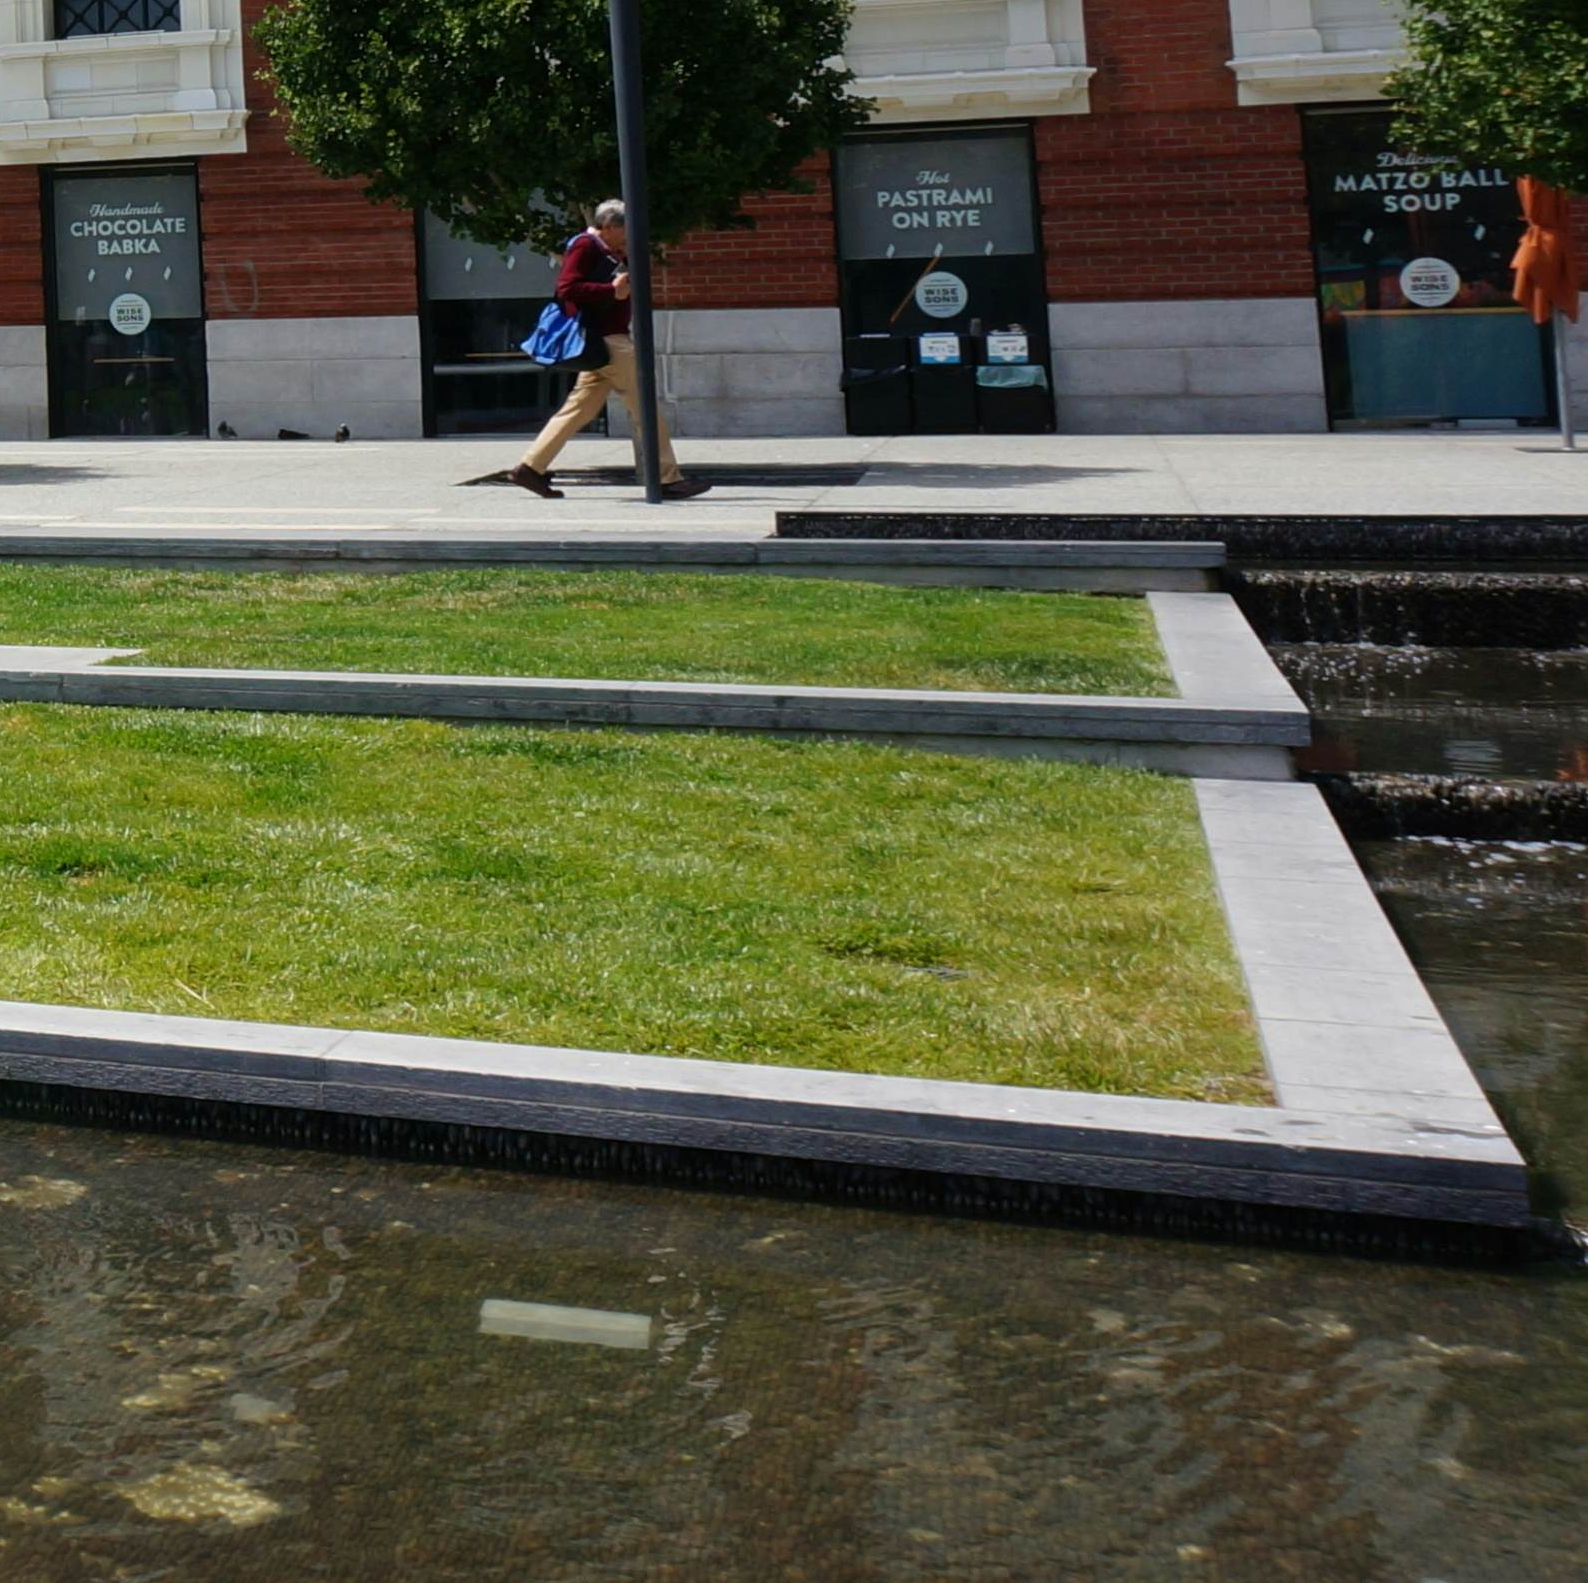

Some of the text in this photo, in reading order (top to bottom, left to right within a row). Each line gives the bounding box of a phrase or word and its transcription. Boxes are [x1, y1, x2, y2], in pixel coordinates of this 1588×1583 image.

[916, 170, 950, 185] Hot
[1334, 171, 1431, 192] MATZO
[1441, 169, 1510, 188] BALL
[877, 187, 994, 208] PASTRAMI
[1383, 193, 1461, 213] SOUP
[90, 201, 165, 218] Handmade
[70, 218, 186, 237] CHOCOLATE
[892, 210, 981, 229] ON RYE
[98, 238, 161, 255] BABKA
[1409, 283, 1450, 291] SONS
[1410, 274, 1449, 283] WISE
[924, 287, 959, 295] WISE
[116, 307, 143, 315] WISE
